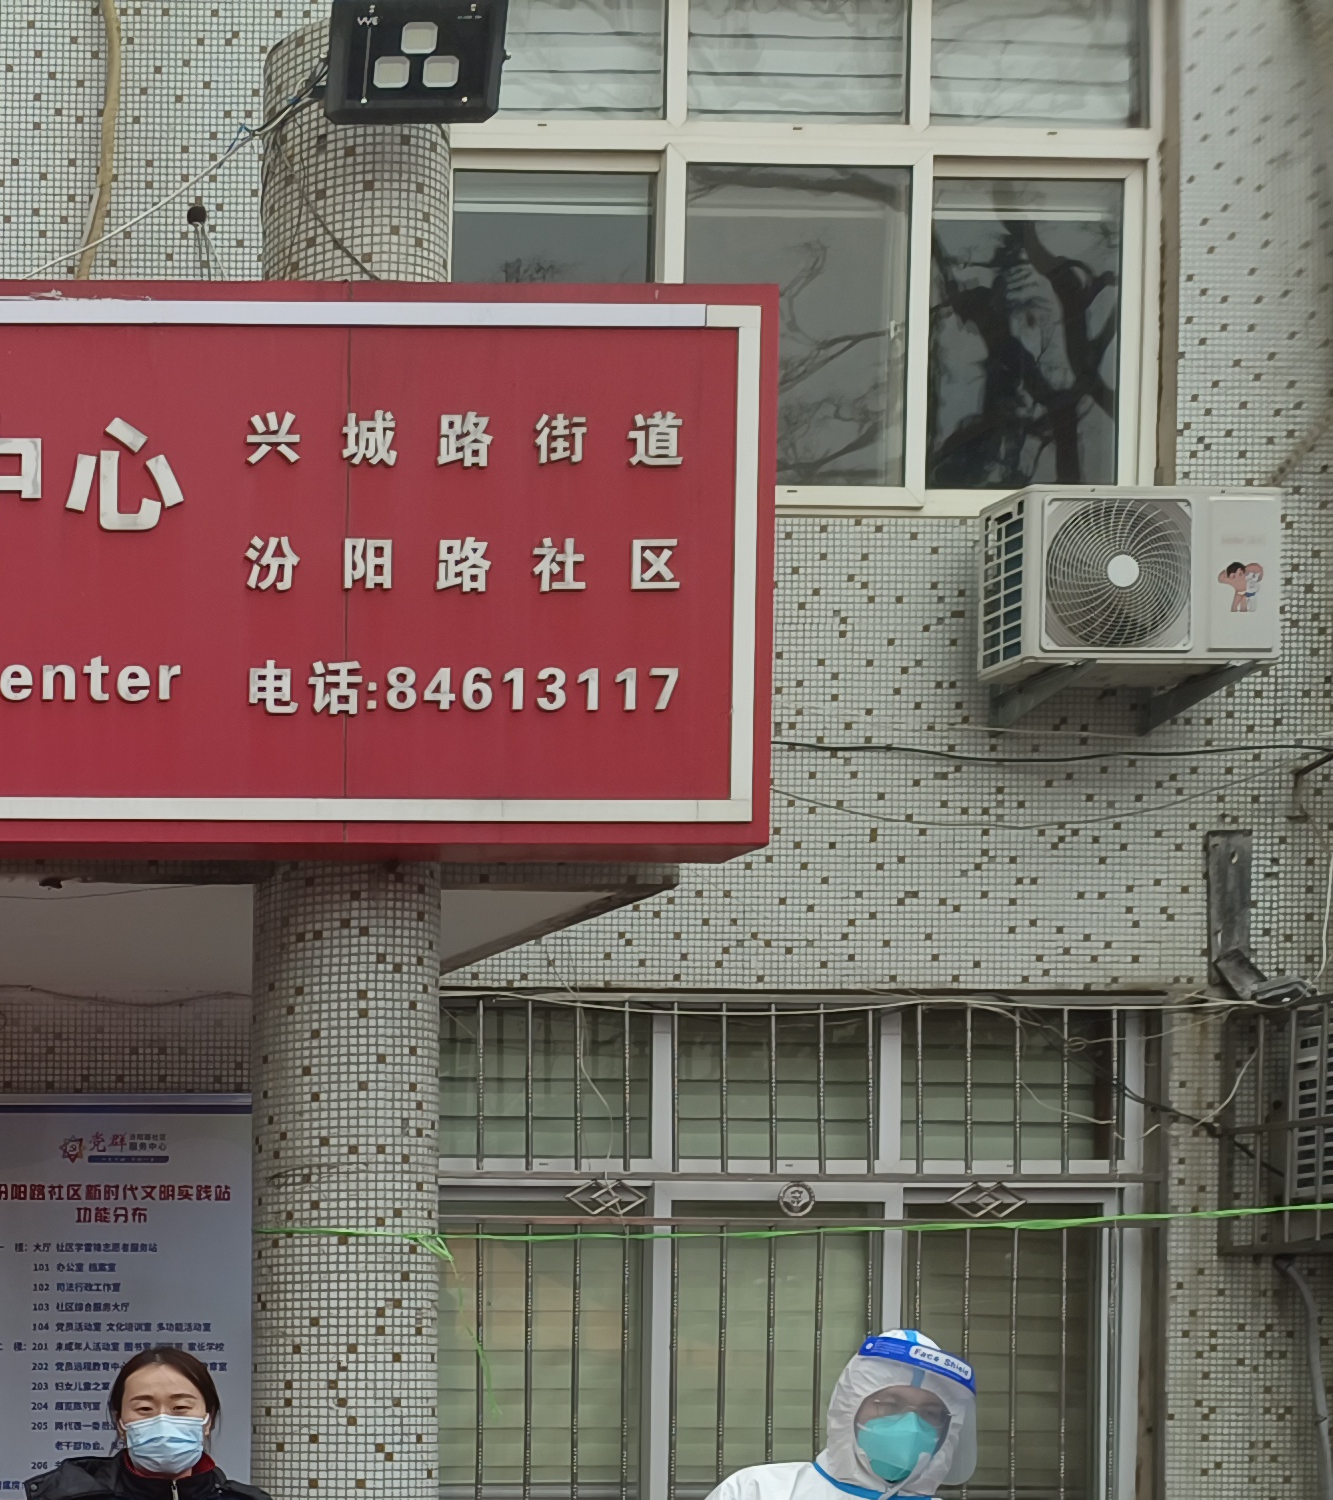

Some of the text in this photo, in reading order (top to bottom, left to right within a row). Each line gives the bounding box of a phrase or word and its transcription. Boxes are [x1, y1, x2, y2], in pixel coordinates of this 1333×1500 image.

[244, 408, 686, 468] 兴城路街道
[243, 535, 684, 594] 汾阳路社区
[246, 658, 683, 720] 电话:84613117
[76, 1206, 148, 1224] 功能分布
[32, 1283, 50, 1292] 102
[32, 1303, 50, 1312] 103
[32, 1323, 50, 1332] 104
[913, 1348, 940, 1362] Face
[31, 1362, 49, 1371] 202
[31, 1382, 49, 1391] 203
[30, 1402, 49, 1411] 204
[30, 1422, 48, 1431] 205
